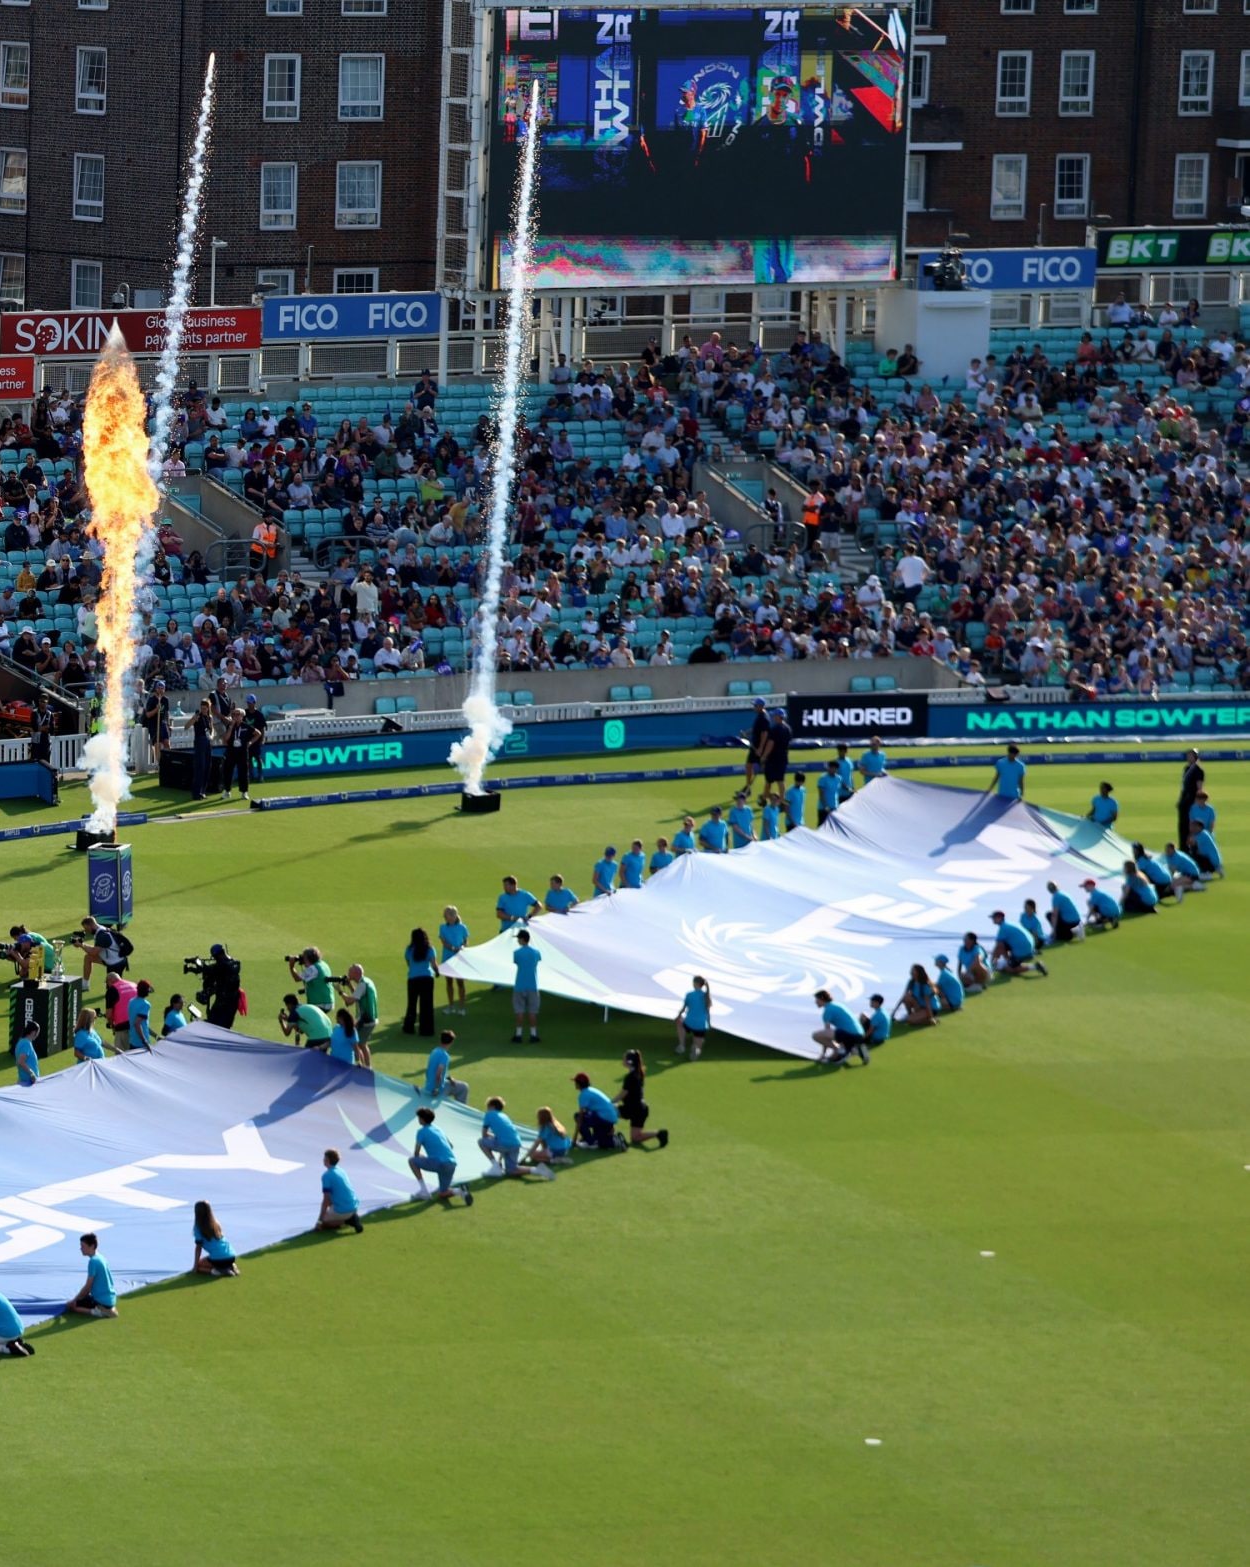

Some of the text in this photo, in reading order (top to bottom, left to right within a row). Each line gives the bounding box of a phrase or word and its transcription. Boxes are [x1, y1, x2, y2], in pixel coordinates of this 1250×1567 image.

[1109, 235, 1179, 259] BKT
[1022, 256, 1082, 283] FICO
[278, 304, 339, 331] FICO
[368, 301, 428, 329] FICO
[205, 331, 248, 346] partner
[802, 707, 913, 727] HUNDRED
[966, 707, 1250, 731] NATHAN SOWTER
[287, 742, 403, 768] SOWTER
[750, 823, 1052, 947] TEAM
